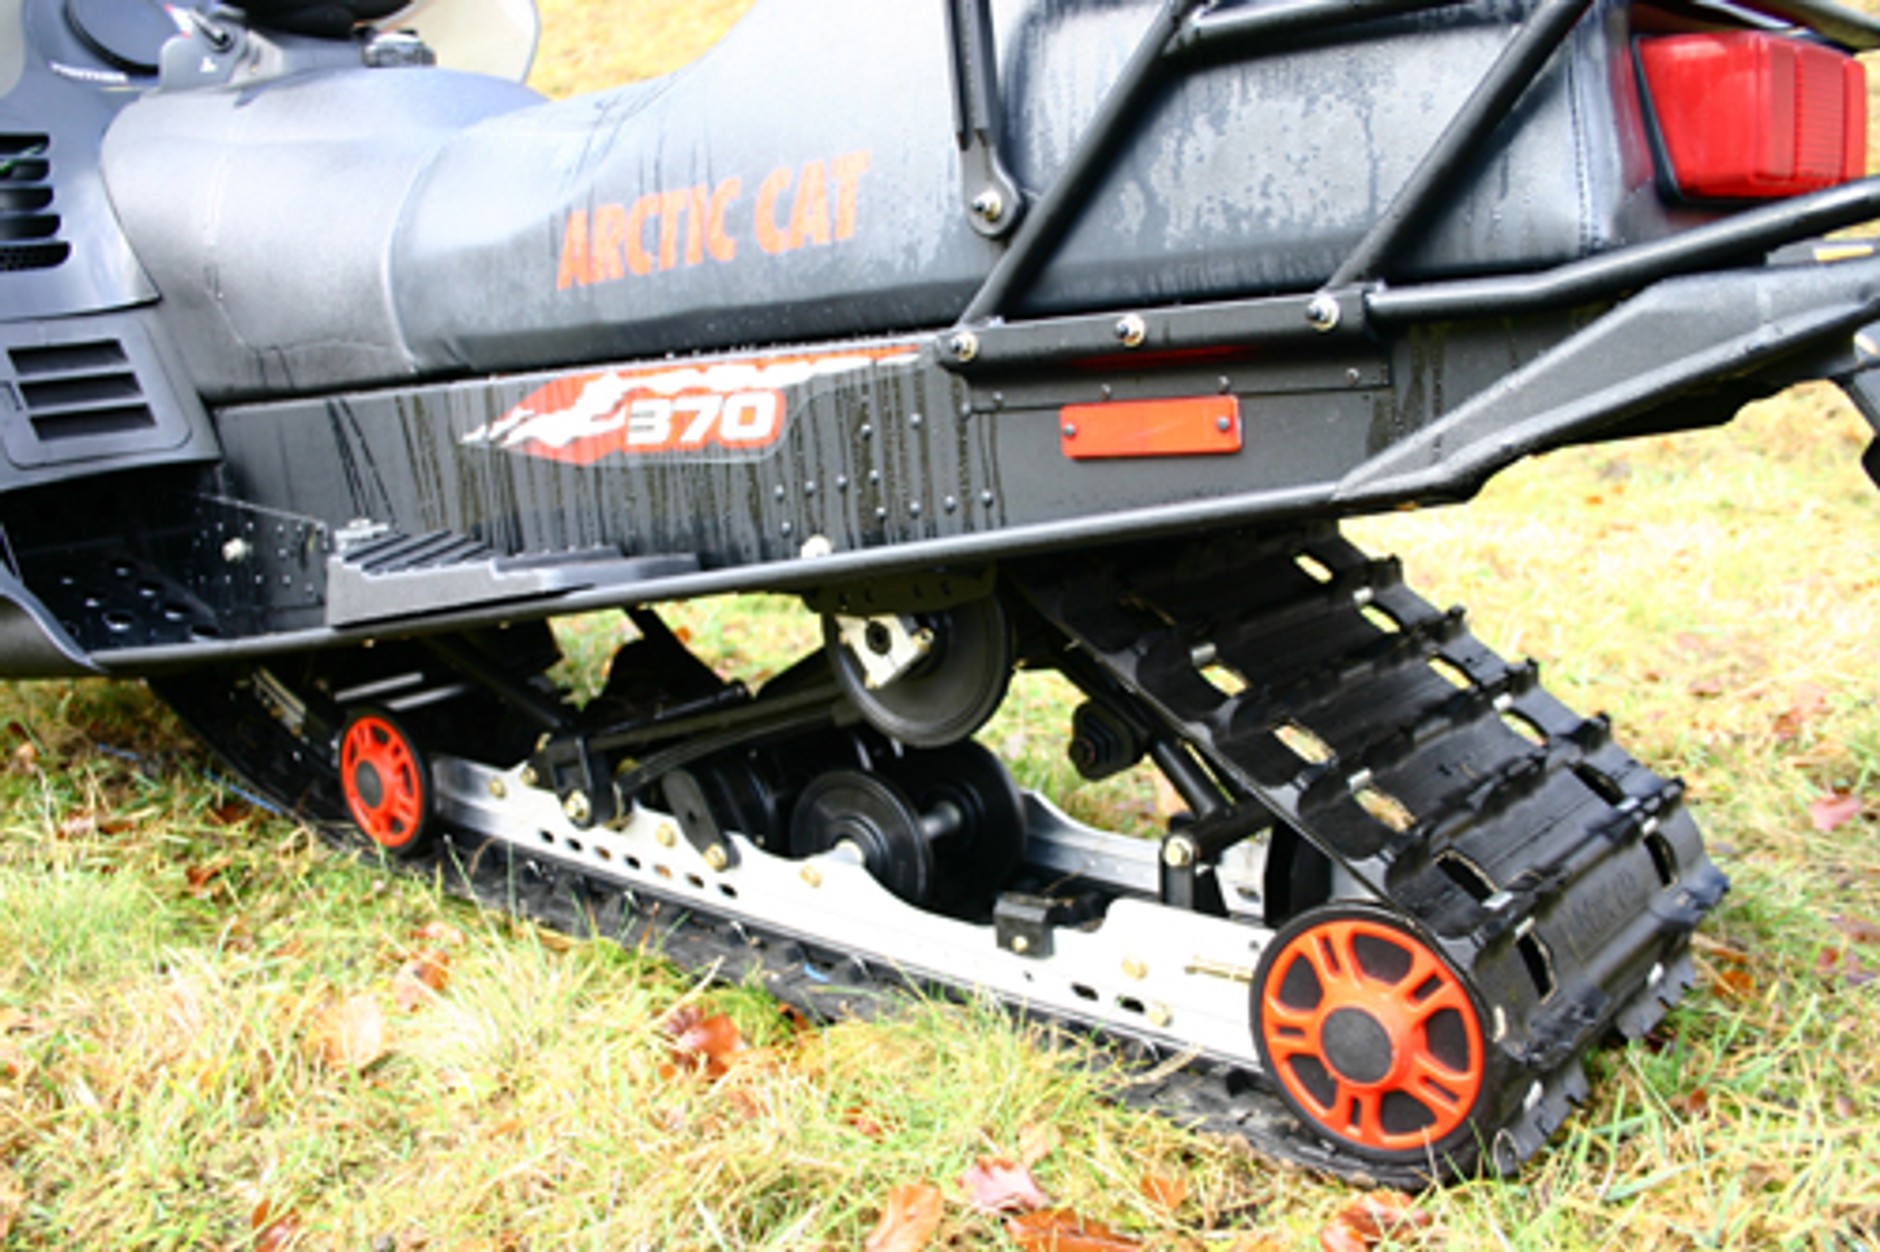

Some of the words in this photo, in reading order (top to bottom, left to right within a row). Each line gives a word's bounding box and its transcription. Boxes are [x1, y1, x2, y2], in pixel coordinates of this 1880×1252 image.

[557, 177, 741, 290] ARCTIC
[755, 150, 871, 254] CAT
[627, 391, 777, 445] 370
